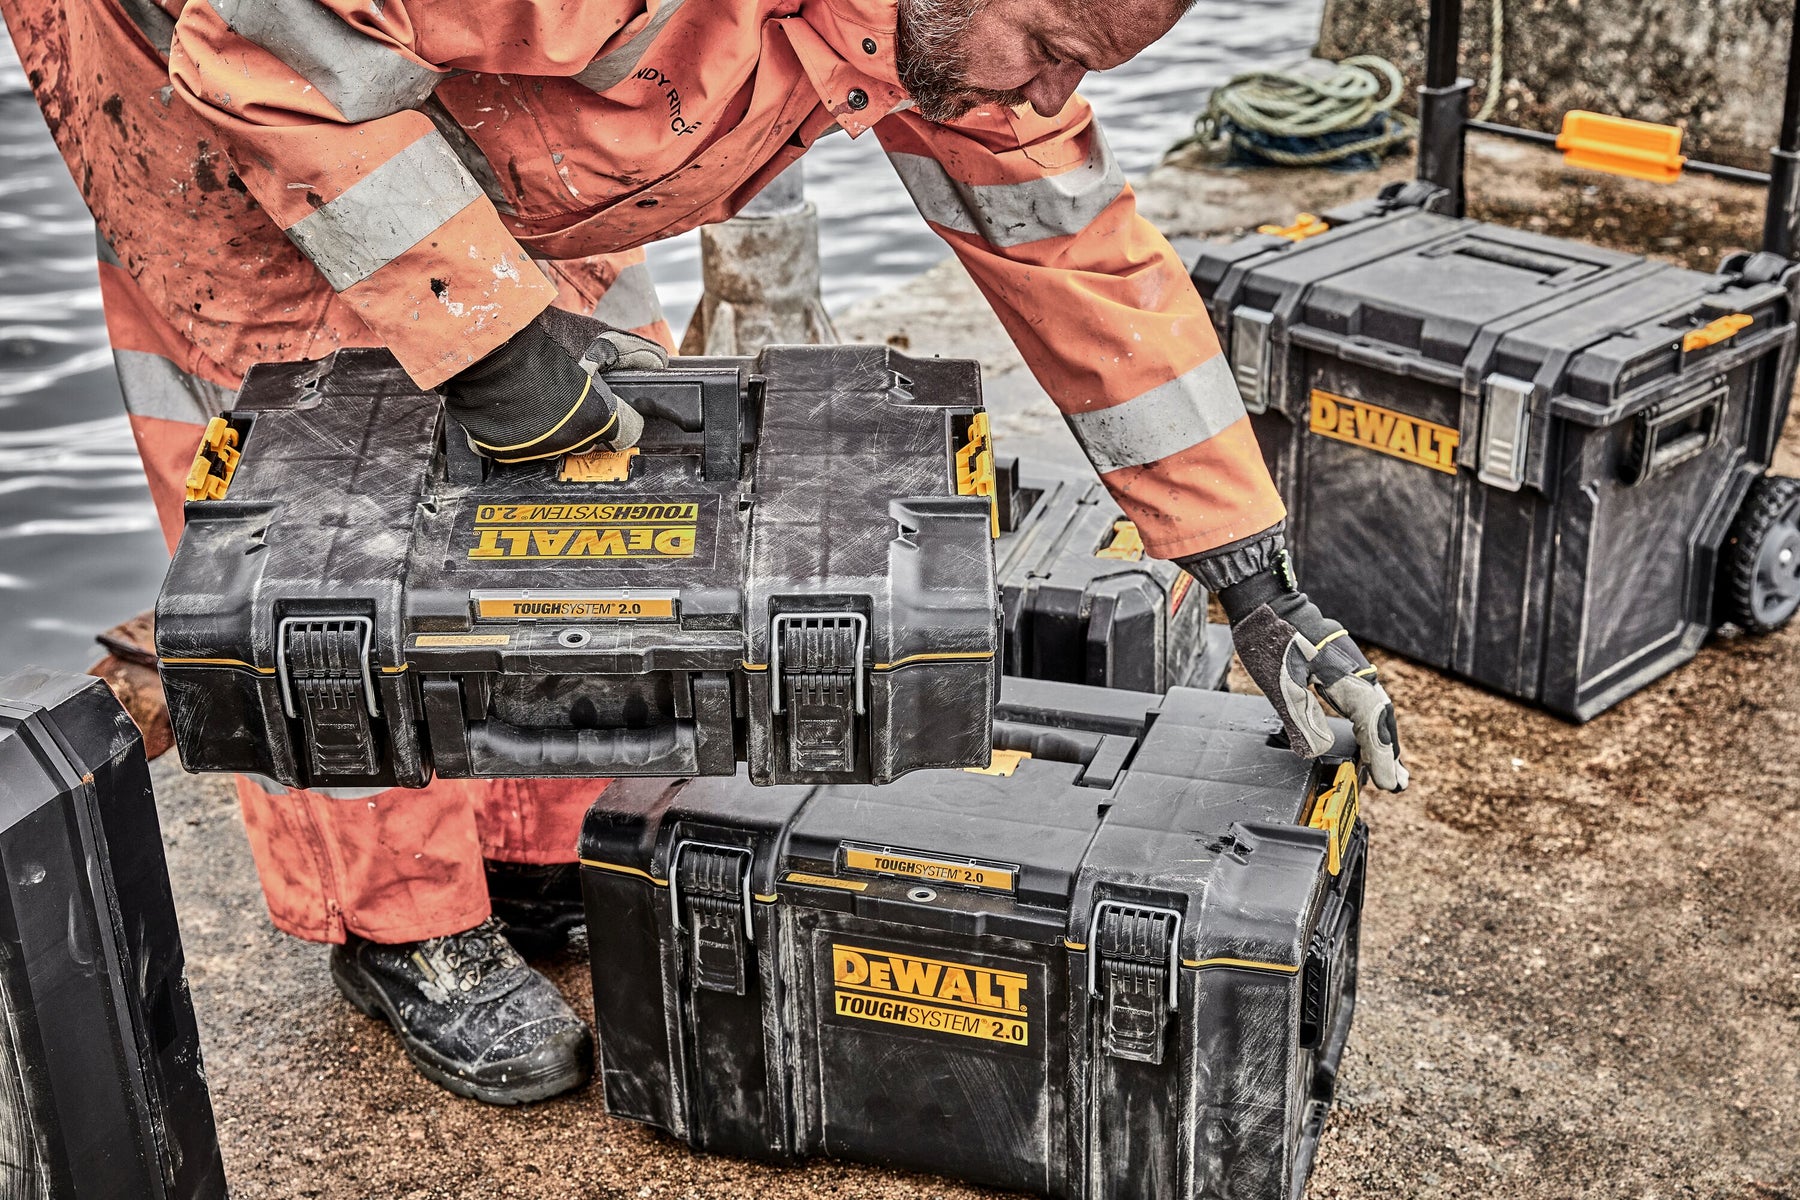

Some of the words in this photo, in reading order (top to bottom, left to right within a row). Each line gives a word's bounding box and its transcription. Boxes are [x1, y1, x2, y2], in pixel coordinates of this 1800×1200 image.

[631, 67, 671, 87] NDY
[1310, 398, 1460, 467] DEWALT
[480, 506, 518, 520] 2.0
[467, 529, 696, 556] DEWALT
[618, 602, 641, 615] 2.0
[964, 870, 984, 884] 2.0
[833, 948, 1028, 1012] DEWALT
[992, 1021, 1024, 1041] 2.0
